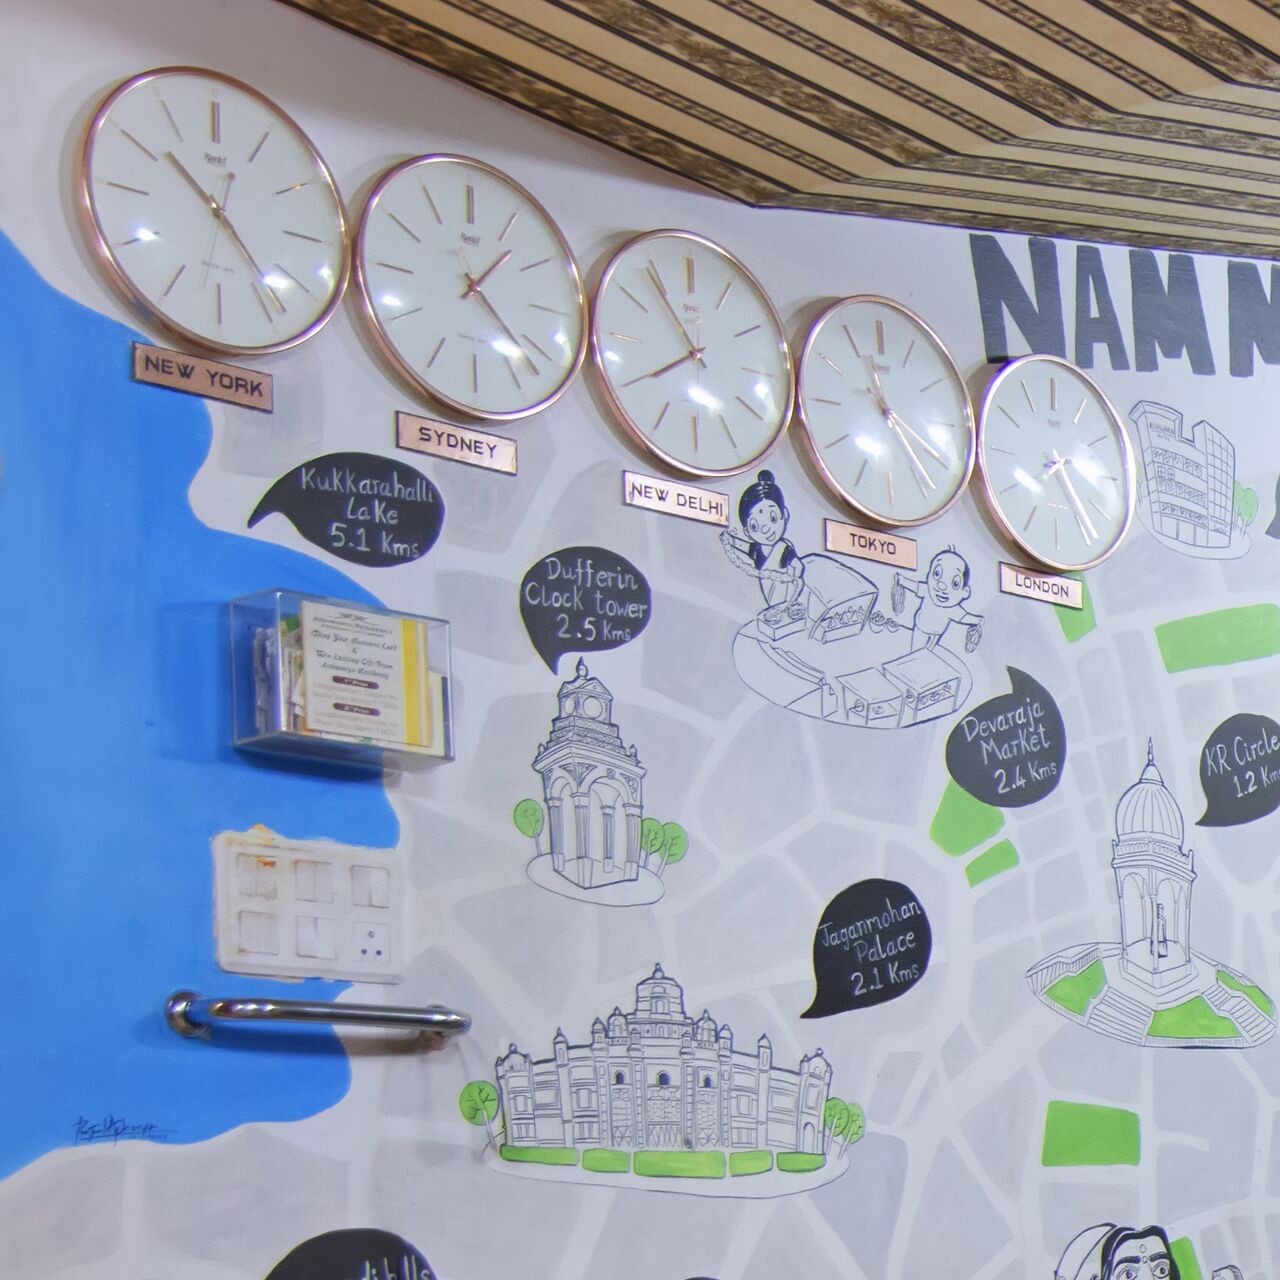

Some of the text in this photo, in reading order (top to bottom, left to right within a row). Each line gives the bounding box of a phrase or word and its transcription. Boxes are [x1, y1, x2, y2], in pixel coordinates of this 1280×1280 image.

[144, 354, 264, 397] NEW YORK
[419, 426, 498, 458] SYDNEY
[632, 483, 723, 517] NEW DELHI
[331, 523, 419, 559] 5.1 Kms
[850, 532, 896, 555] TOKYO
[545, 557, 638, 591] Dufferin
[1015, 569, 1069, 598] LONDON
[525, 582, 648, 619] Clock tower
[557, 614, 631, 642] 2.5 Kms
[961, 697, 1044, 742] Devaraja
[1205, 728, 1280, 777] KR Circle
[994, 760, 1057, 794] 2.4 Kms
[1233, 771, 1258, 798] 1.2
[818, 898, 921, 950] Jaganmohan
[853, 931, 917, 964] Palace
[851, 961, 919, 996] 2.1 Kms
